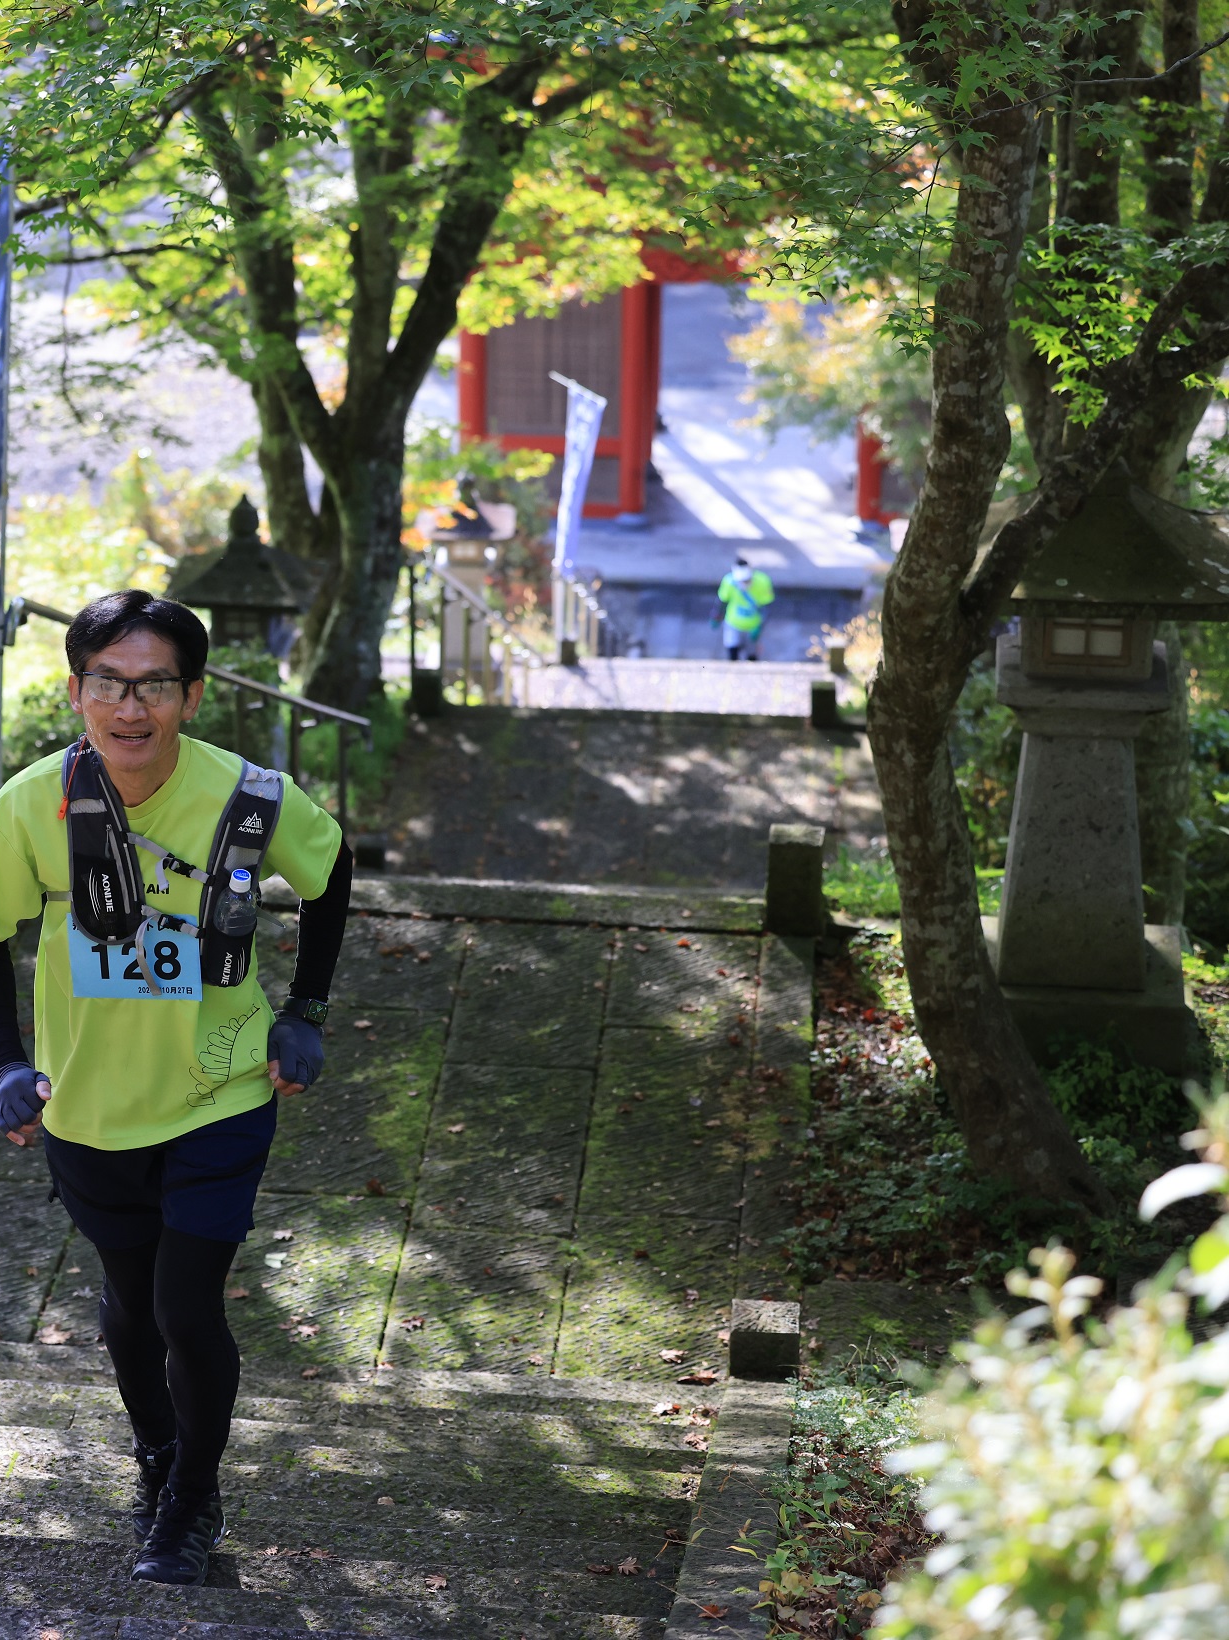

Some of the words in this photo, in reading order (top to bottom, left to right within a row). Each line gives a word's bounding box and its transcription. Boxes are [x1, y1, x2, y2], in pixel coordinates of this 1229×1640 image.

[101, 873, 114, 912] AONIJIE
[91, 940, 182, 980] 128
[220, 951, 233, 985] AONIJIE
